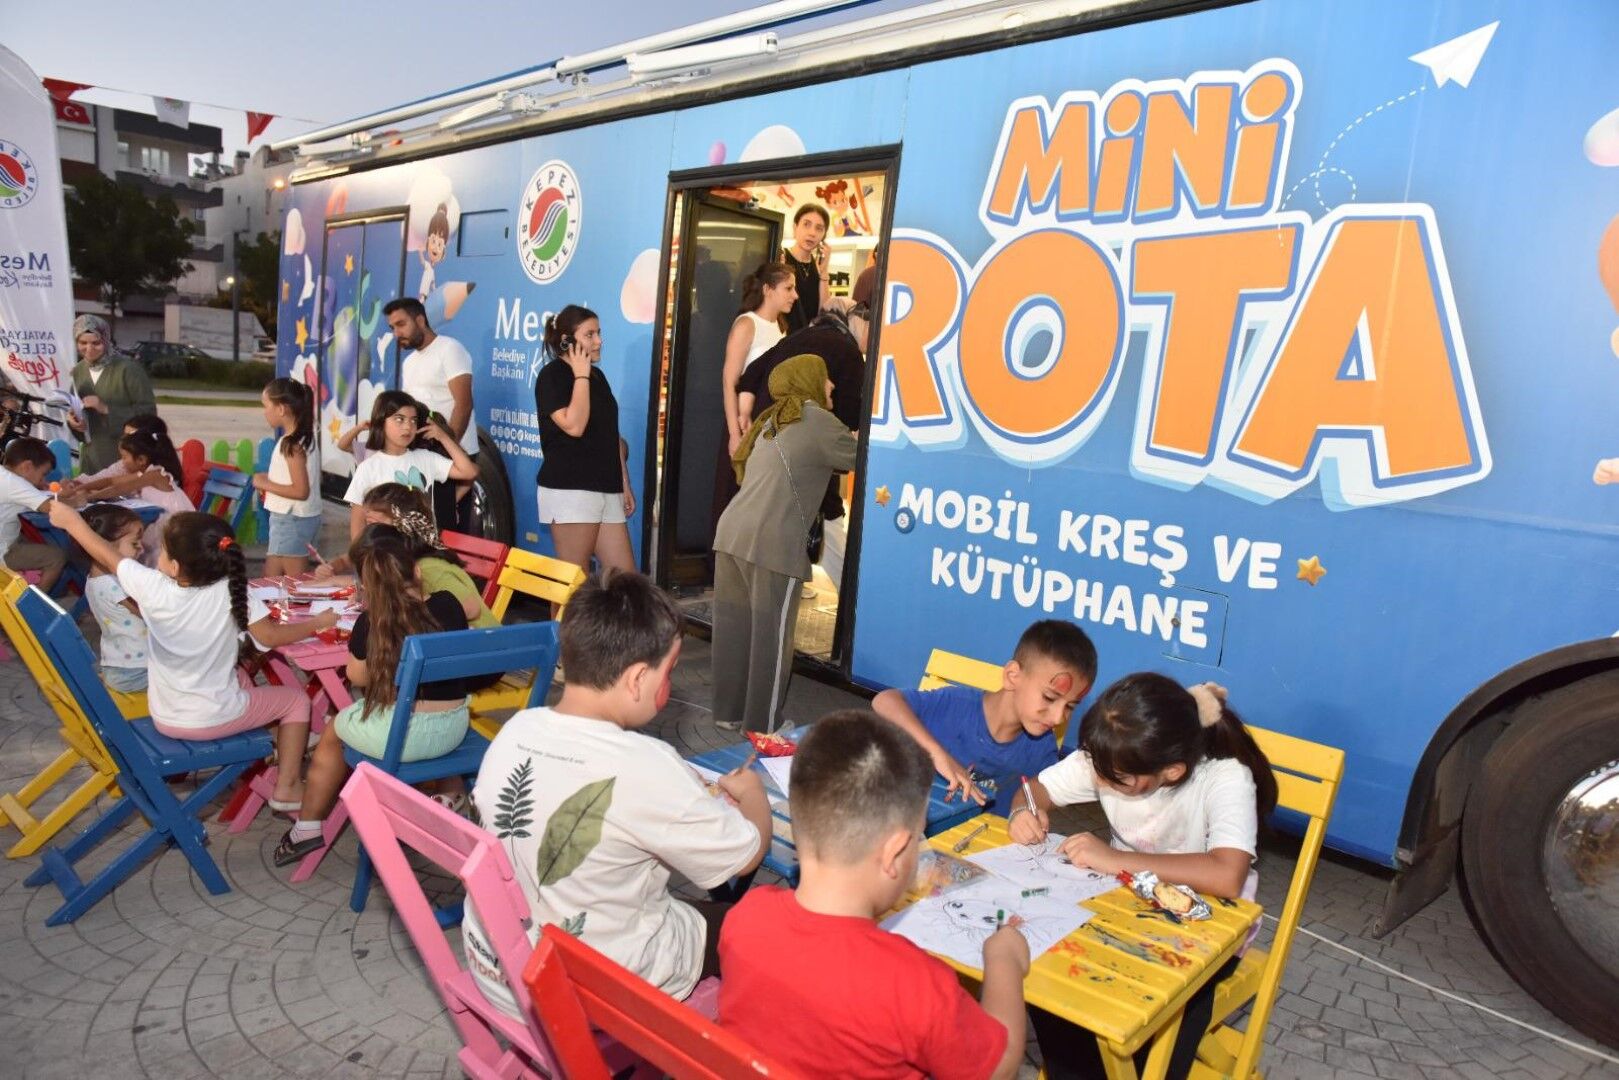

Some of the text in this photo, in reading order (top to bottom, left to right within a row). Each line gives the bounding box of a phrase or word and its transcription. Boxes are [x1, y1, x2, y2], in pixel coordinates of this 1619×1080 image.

[525, 170, 576, 211] KEPEZ
[491, 362, 525, 381] Başkanı
[492, 347, 526, 366] Belediye
[867, 212, 1488, 492] ROTA
[900, 482, 1282, 590] MOBİL KREŞ VE
[931, 543, 1209, 648] KÜTÜPHANE
